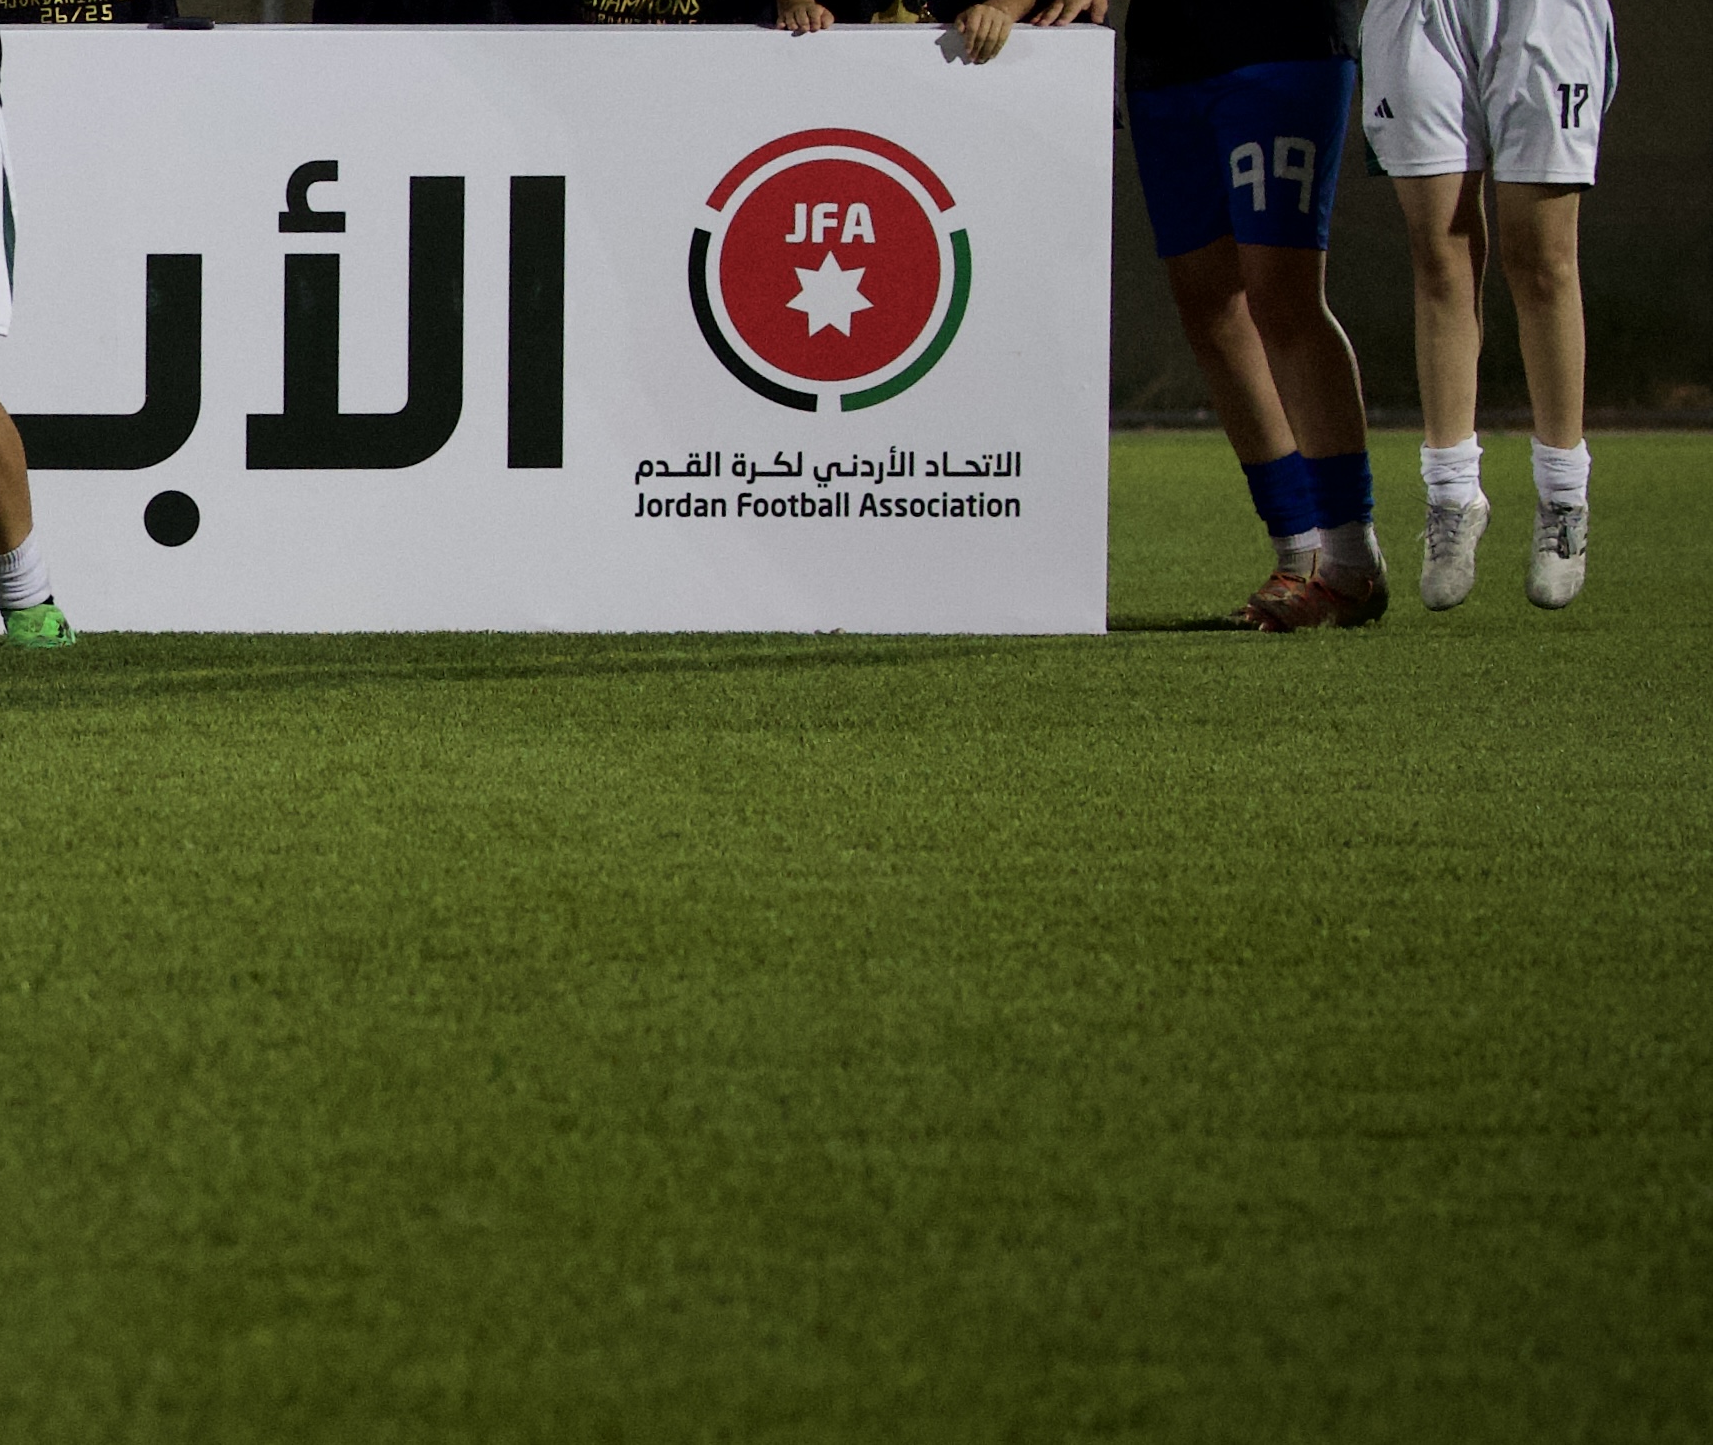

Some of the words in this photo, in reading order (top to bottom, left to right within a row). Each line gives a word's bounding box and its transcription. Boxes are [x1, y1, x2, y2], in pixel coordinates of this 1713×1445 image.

[40, 4, 113, 24] 26/25
[1230, 136, 1316, 214] 99
[786, 203, 875, 243] JFA
[635, 451, 720, 485] القدم
[732, 451, 802, 484] لكرة
[814, 446, 914, 488] الأردني
[925, 451, 1021, 478] الاتحاد
[635, 492, 726, 518] Jordan
[738, 492, 849, 518] Football
[859, 492, 1020, 518] Association
